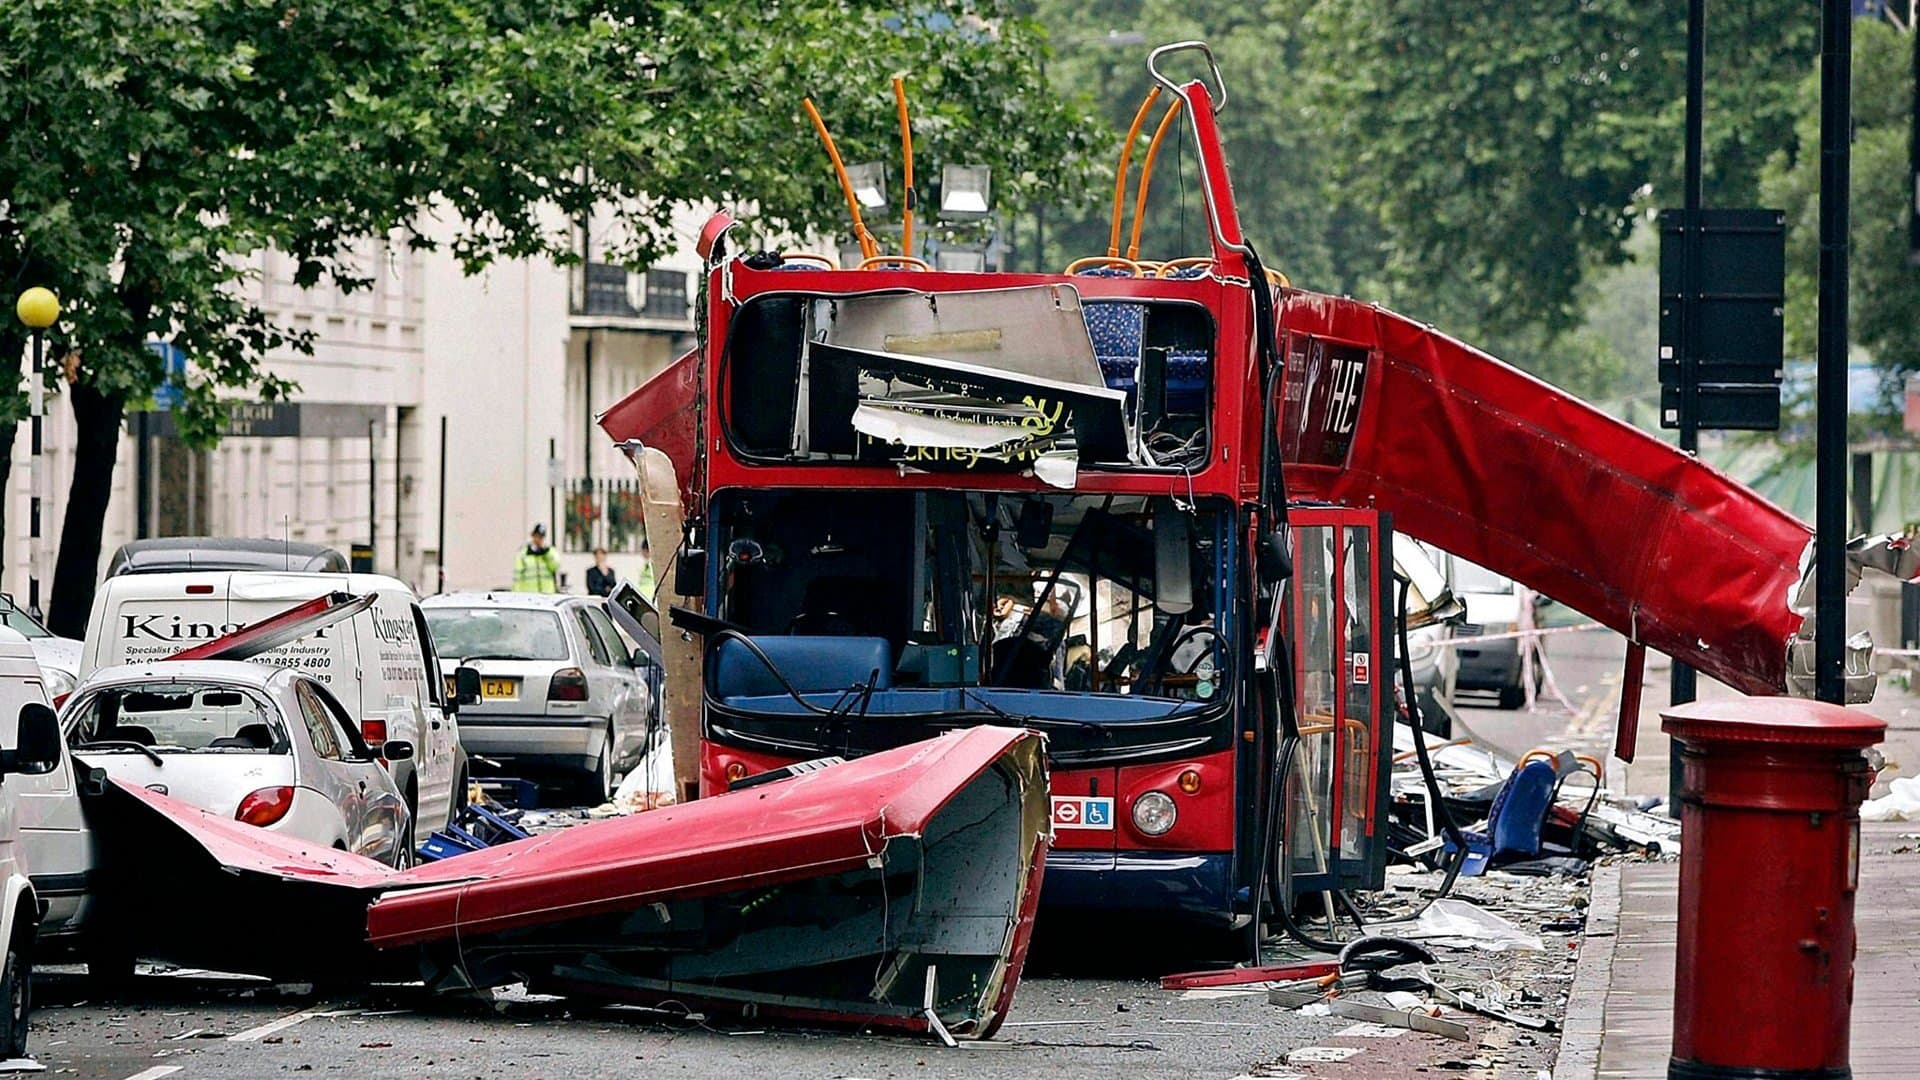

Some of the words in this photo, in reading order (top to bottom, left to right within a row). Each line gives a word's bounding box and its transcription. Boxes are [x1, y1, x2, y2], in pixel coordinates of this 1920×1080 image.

[1321, 359, 1364, 433] THE
[934, 411, 981, 425] Chadwell
[125, 646, 171, 656] Specialist
[290, 646, 331, 655] Industry
[303, 657, 331, 668] 4800
[486, 681, 515, 696] CAJ
